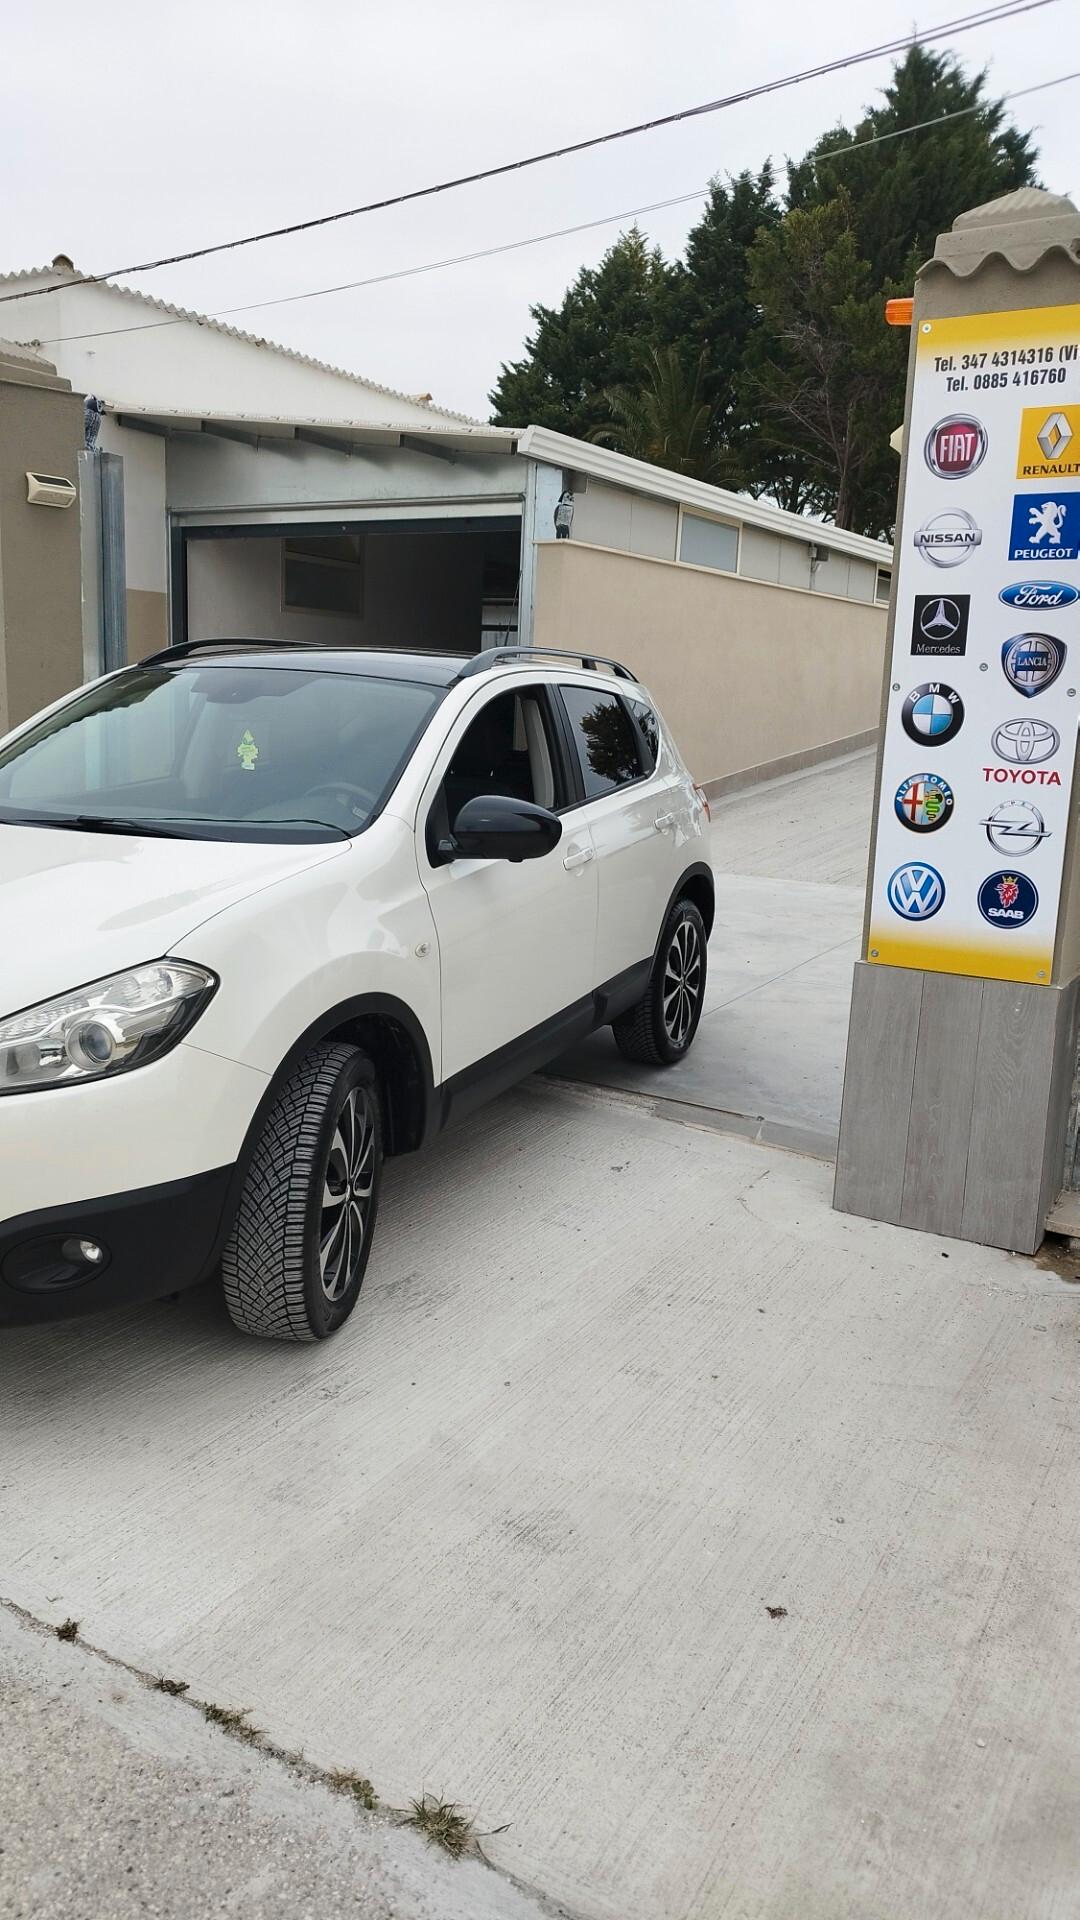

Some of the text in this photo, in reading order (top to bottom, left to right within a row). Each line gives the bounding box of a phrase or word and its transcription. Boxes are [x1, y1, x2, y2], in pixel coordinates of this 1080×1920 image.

[934, 356, 957, 372] Tel.
[961, 353, 987, 370] 347
[991, 346, 1054, 367] 4314316
[946, 368, 1066, 392] Tel. 0885 416760
[940, 433, 976, 462] FIAT
[1022, 463, 1080, 476] RENAULT
[919, 533, 976, 544] NISSAN
[1014, 548, 1073, 560] PEUGEOT
[1014, 584, 1063, 605] Ford
[915, 643, 961, 654] Mercedes
[1017, 656, 1047, 666] LANCIA
[909, 683, 960, 704] BMW
[983, 768, 1061, 785] TOYOTA
[988, 908, 1024, 919] SAAB
